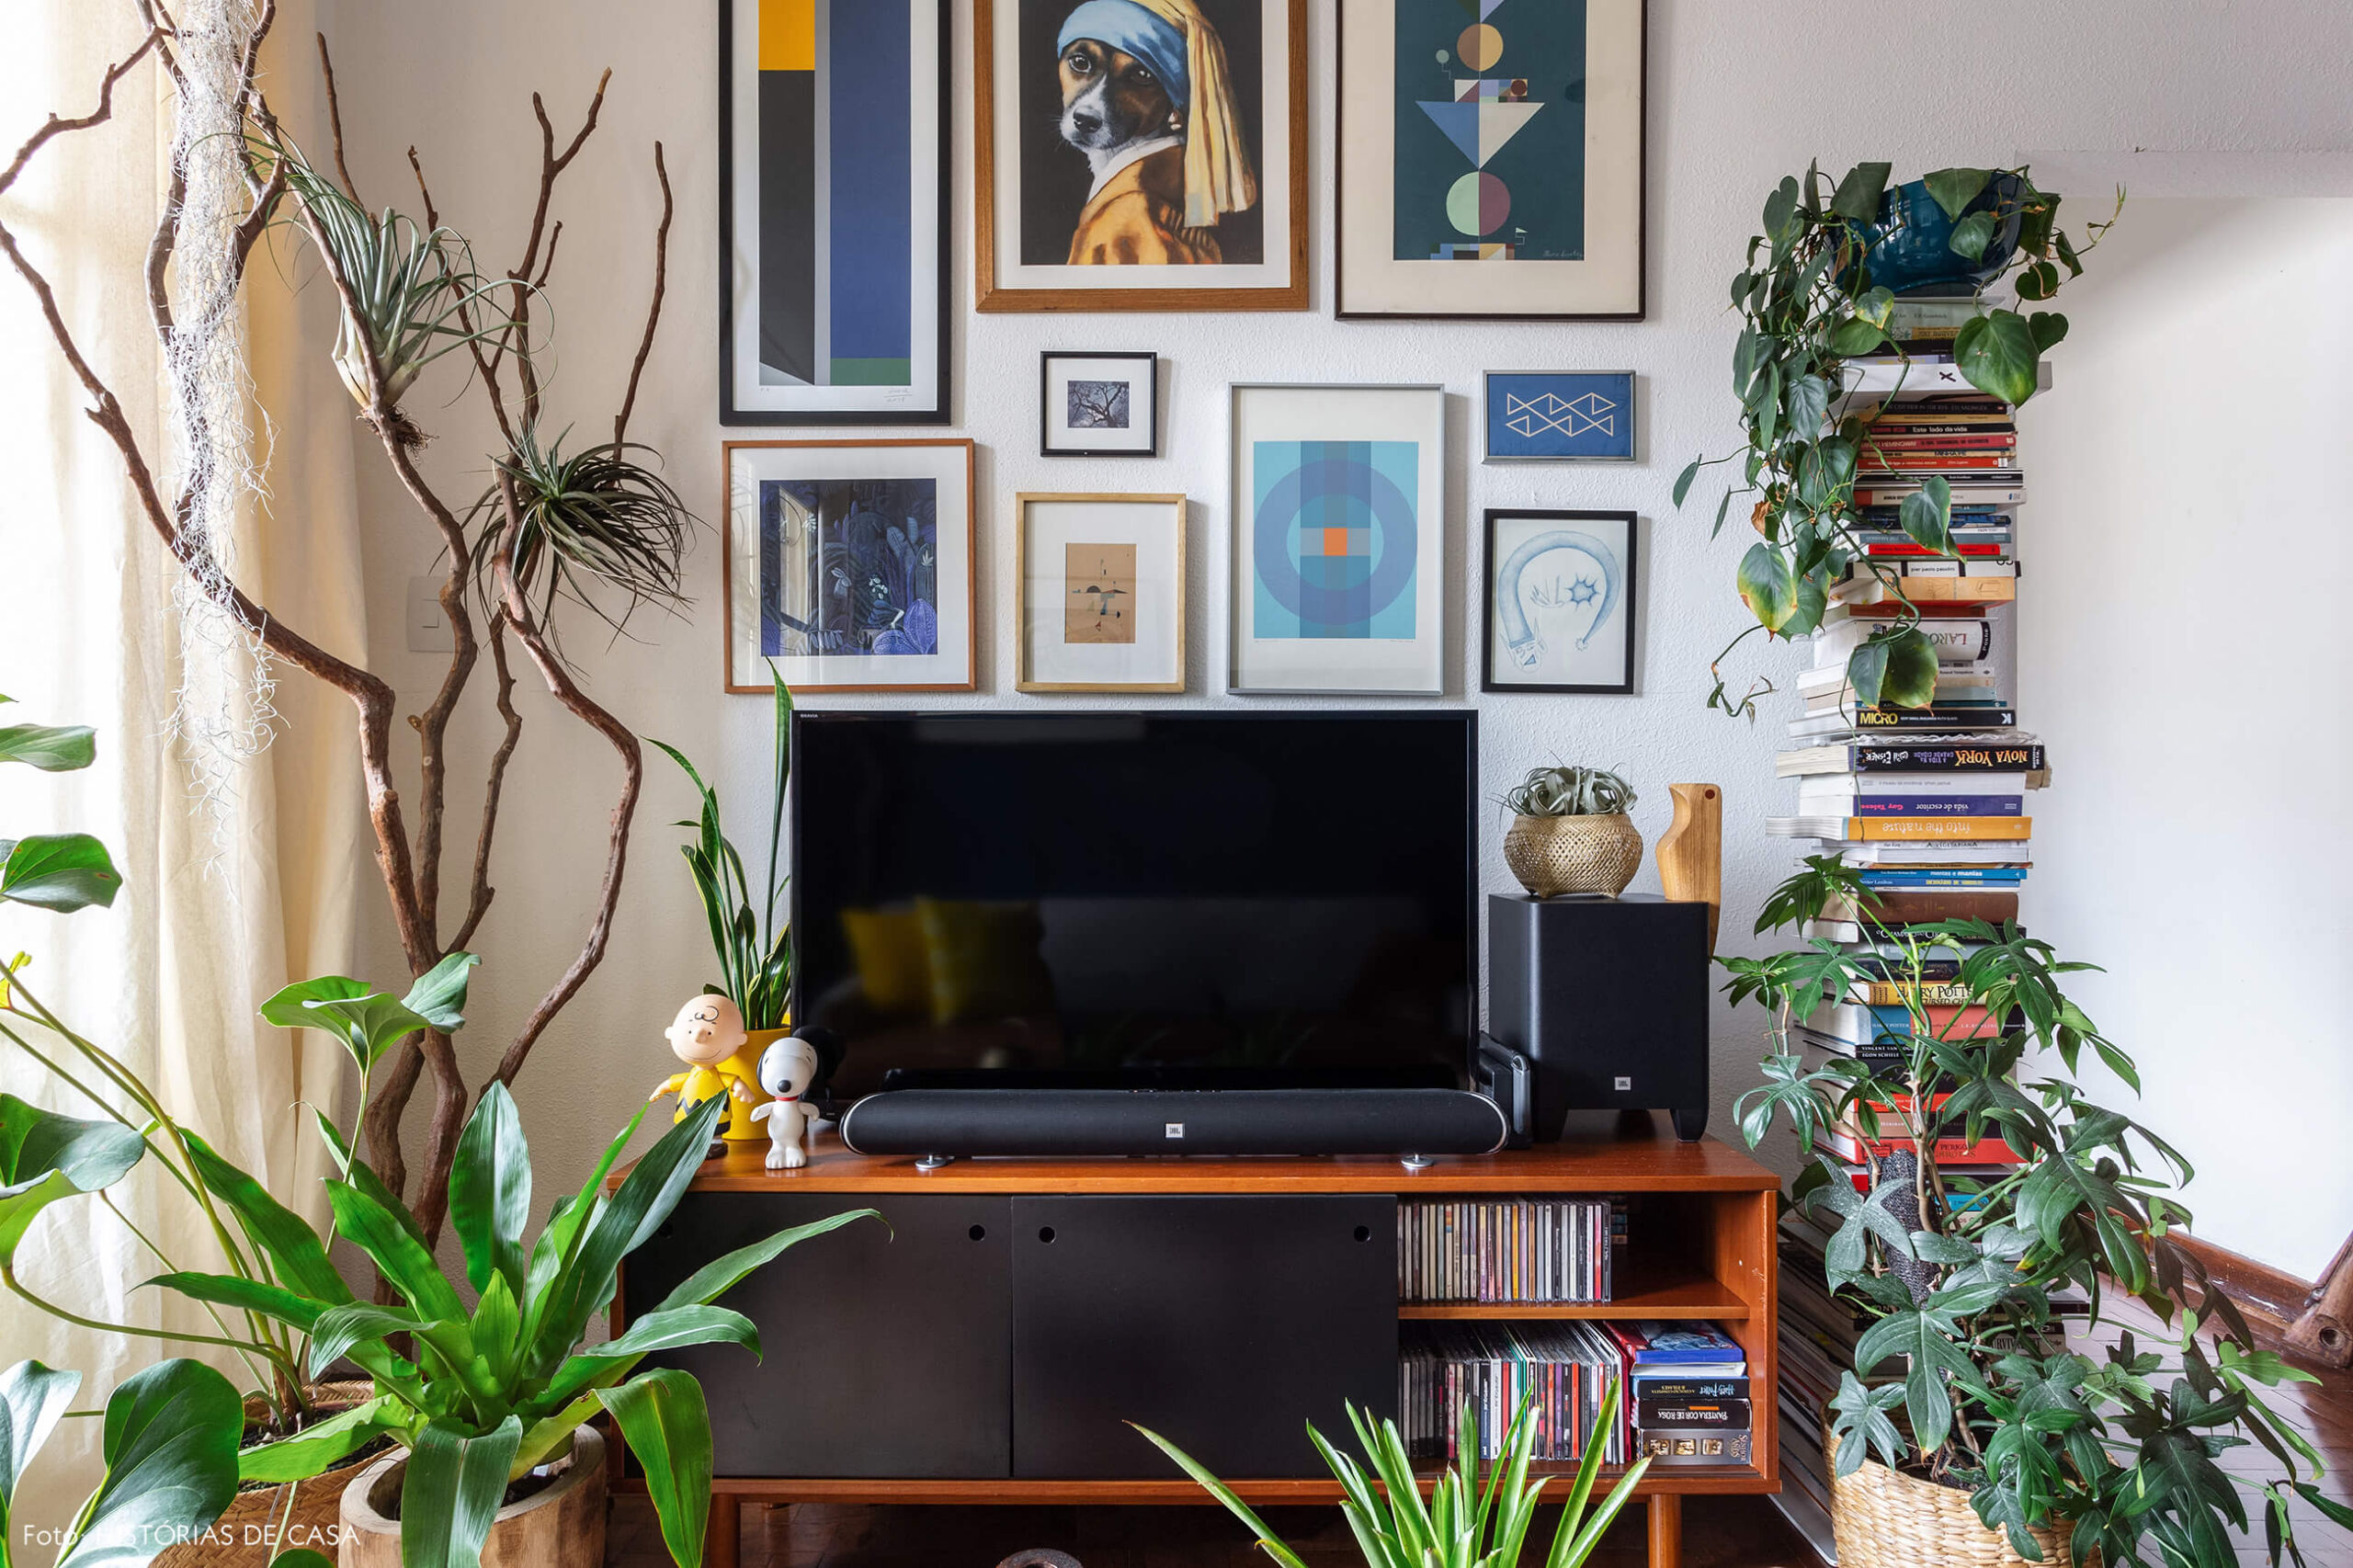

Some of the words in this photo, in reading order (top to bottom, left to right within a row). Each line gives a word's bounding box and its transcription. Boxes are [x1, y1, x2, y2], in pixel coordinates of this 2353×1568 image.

[1859, 712, 1899, 724] MICRO
[1954, 749, 1993, 767] YORK
[1995, 749, 2028, 764] NOVA
[1881, 822, 1924, 834] nature
[1925, 822, 1944, 834] the
[1946, 822, 1971, 834] into
[1897, 986, 1934, 998] HRY
[1938, 985, 1972, 998] POTTE
[1657, 1411, 1676, 1420] ROSA
[1676, 1411, 1685, 1420] DE
[1685, 1411, 1699, 1420] COR
[1699, 1411, 1728, 1421] PANTERA
